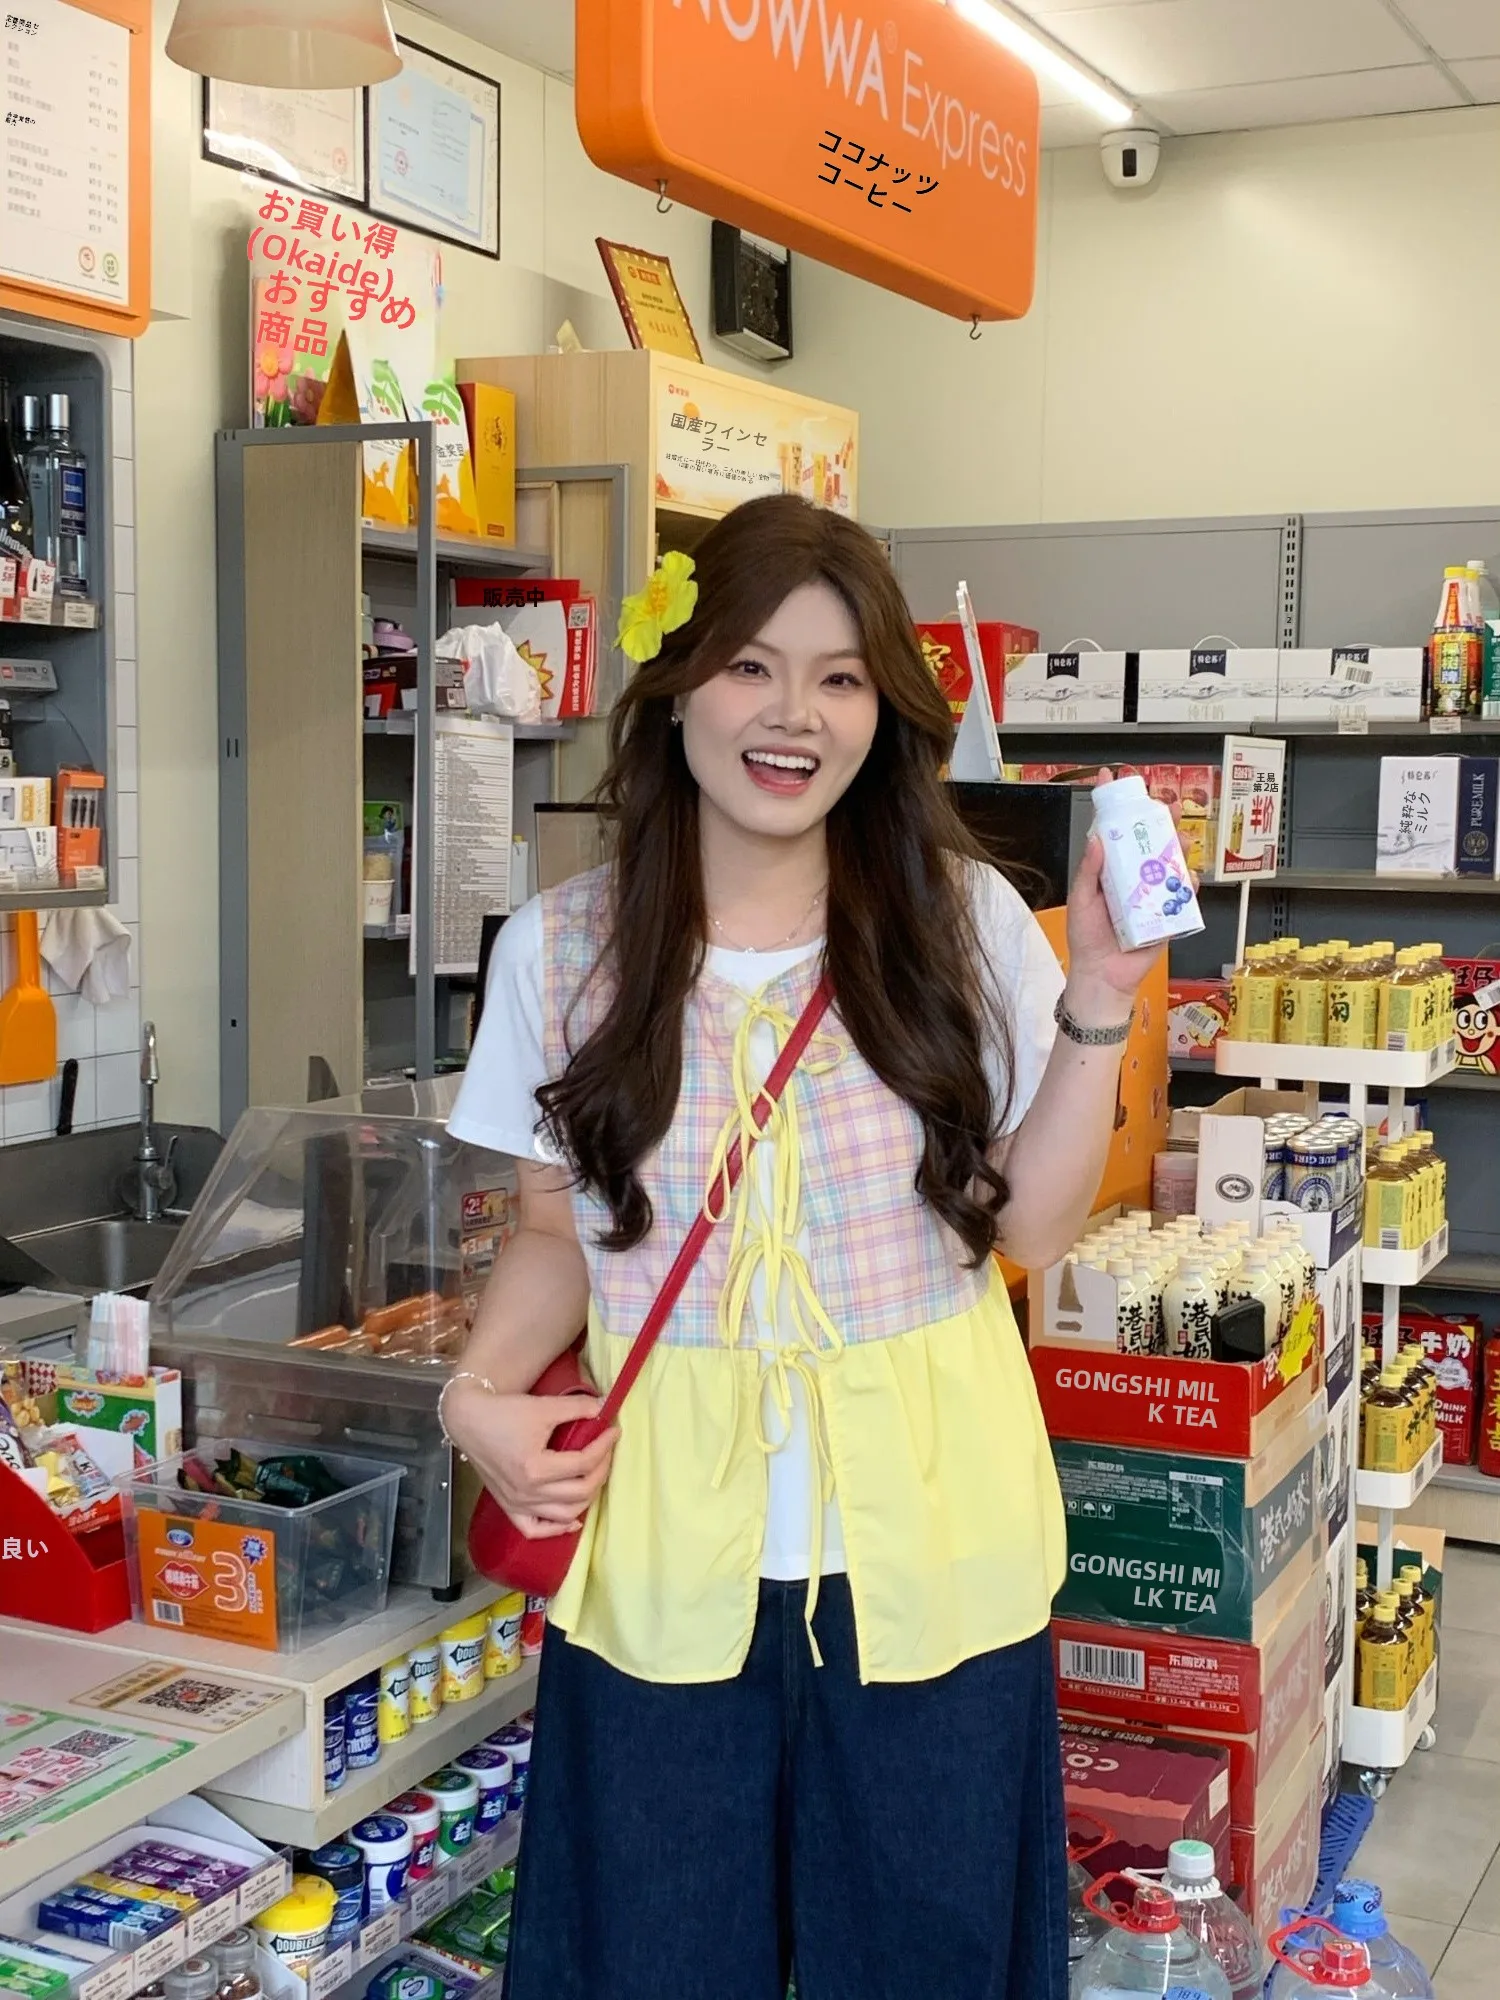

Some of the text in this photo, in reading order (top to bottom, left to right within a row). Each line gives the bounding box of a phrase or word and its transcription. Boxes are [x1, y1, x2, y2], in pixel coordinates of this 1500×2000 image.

[901, 48, 1027, 197] Express
[1250, 795, 1274, 835] 半价
[1420, 1331, 1471, 1358] 牛奶
[212, 1551, 248, 1612] 3
